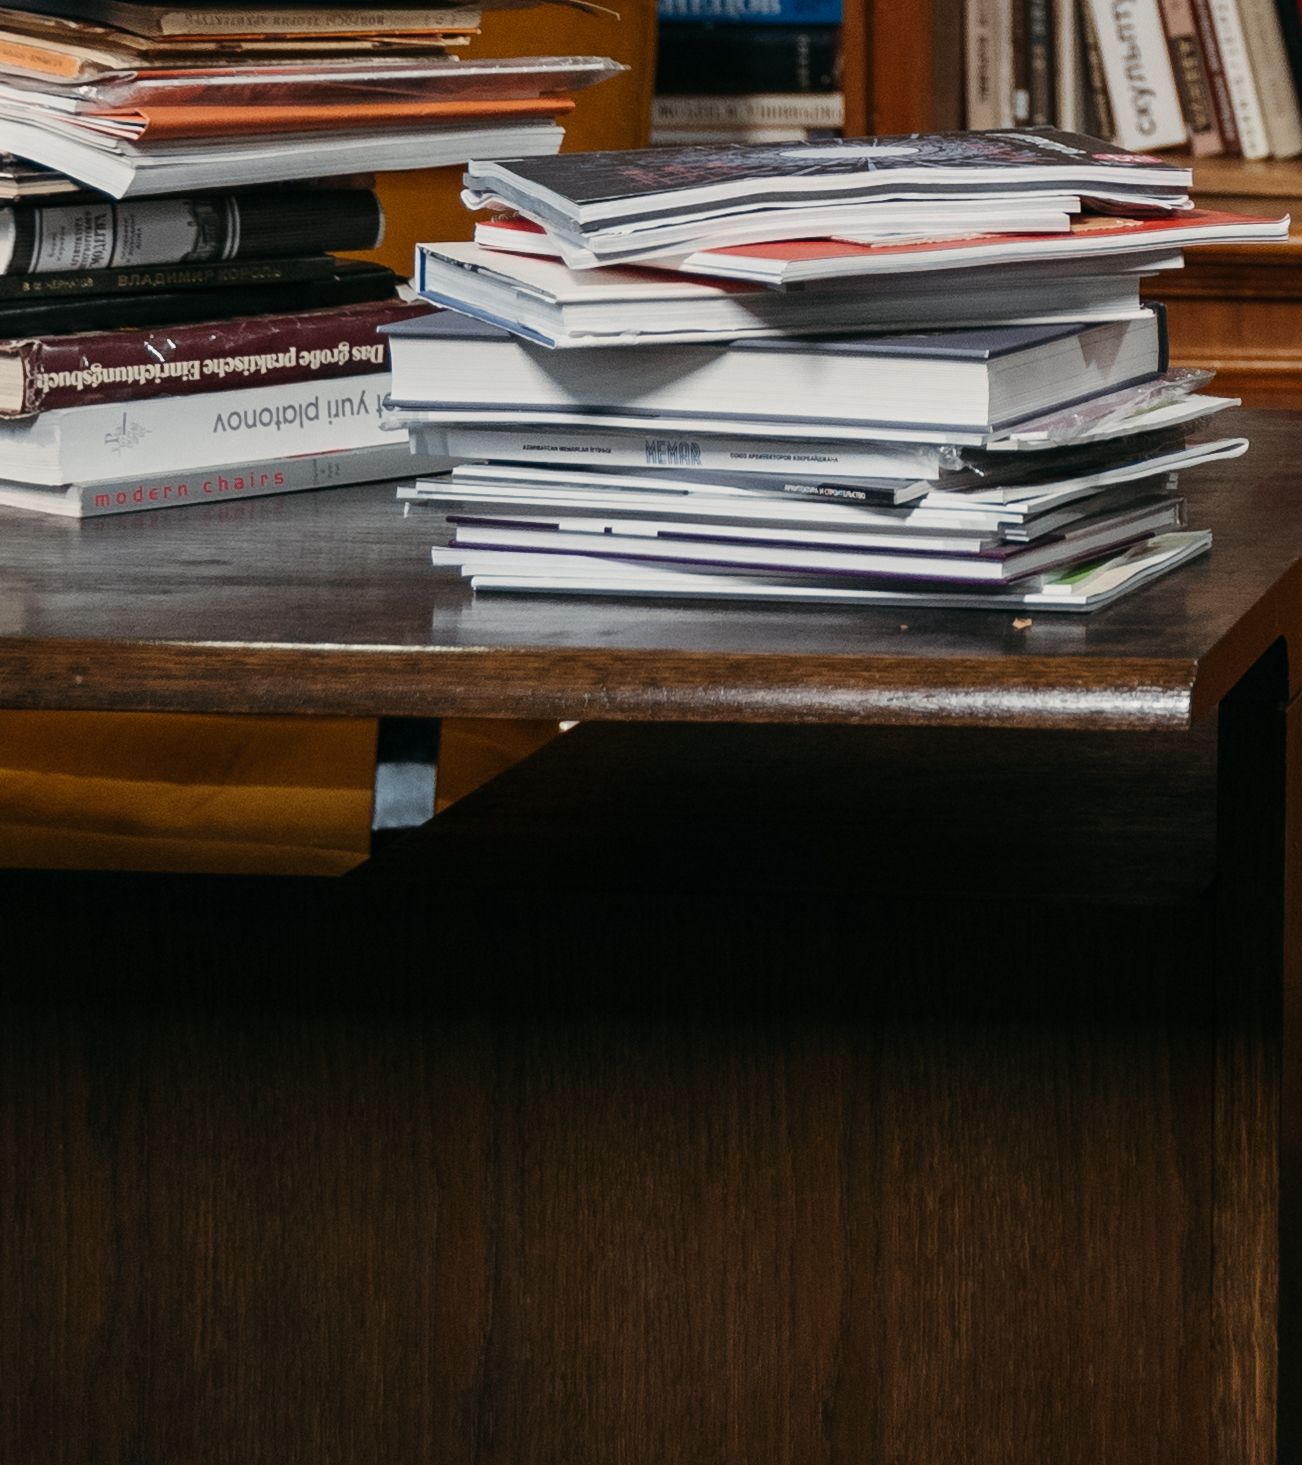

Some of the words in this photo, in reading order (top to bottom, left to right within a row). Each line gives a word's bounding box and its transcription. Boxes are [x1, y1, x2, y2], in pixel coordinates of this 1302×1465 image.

[117, 271, 211, 288] ВЛАДИМИР
[202, 345, 297, 377] praktische
[299, 341, 352, 369] große
[352, 343, 385, 365] Das
[37, 358, 201, 392] Einrichtungsbuch
[213, 400, 320, 434] platonov
[327, 390, 367, 422] yuri
[645, 439, 702, 466] MEMAR
[94, 484, 189, 508] modern
[203, 470, 286, 495] chairs
